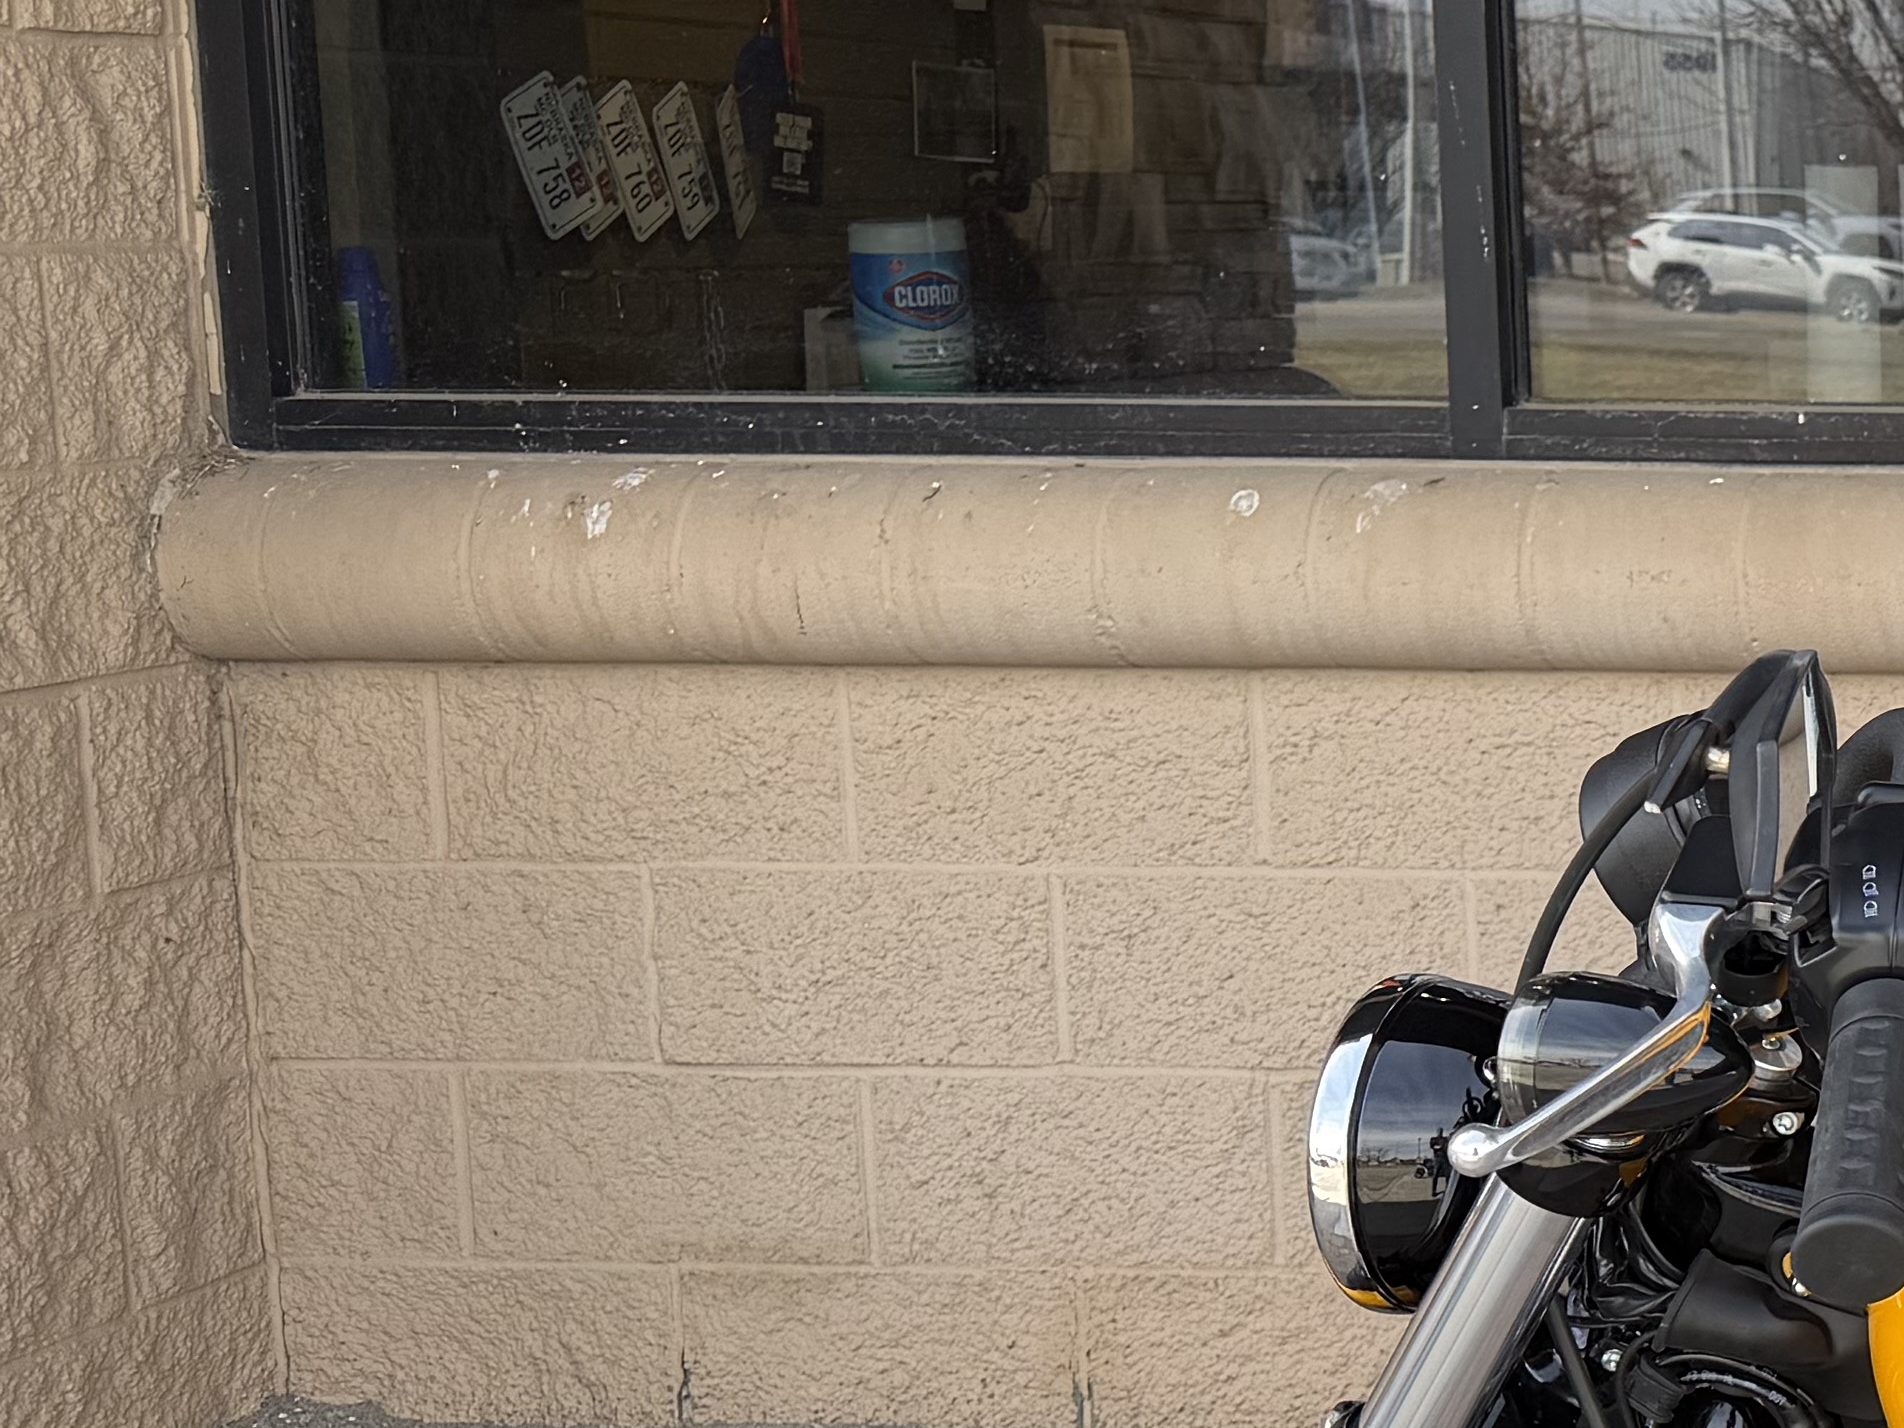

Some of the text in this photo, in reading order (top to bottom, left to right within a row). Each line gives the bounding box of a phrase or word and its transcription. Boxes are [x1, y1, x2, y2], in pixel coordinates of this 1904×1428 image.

[534, 157, 574, 212] 758
[622, 164, 654, 214] 760
[674, 164, 702, 212] 759
[894, 284, 960, 308] CLOROX
